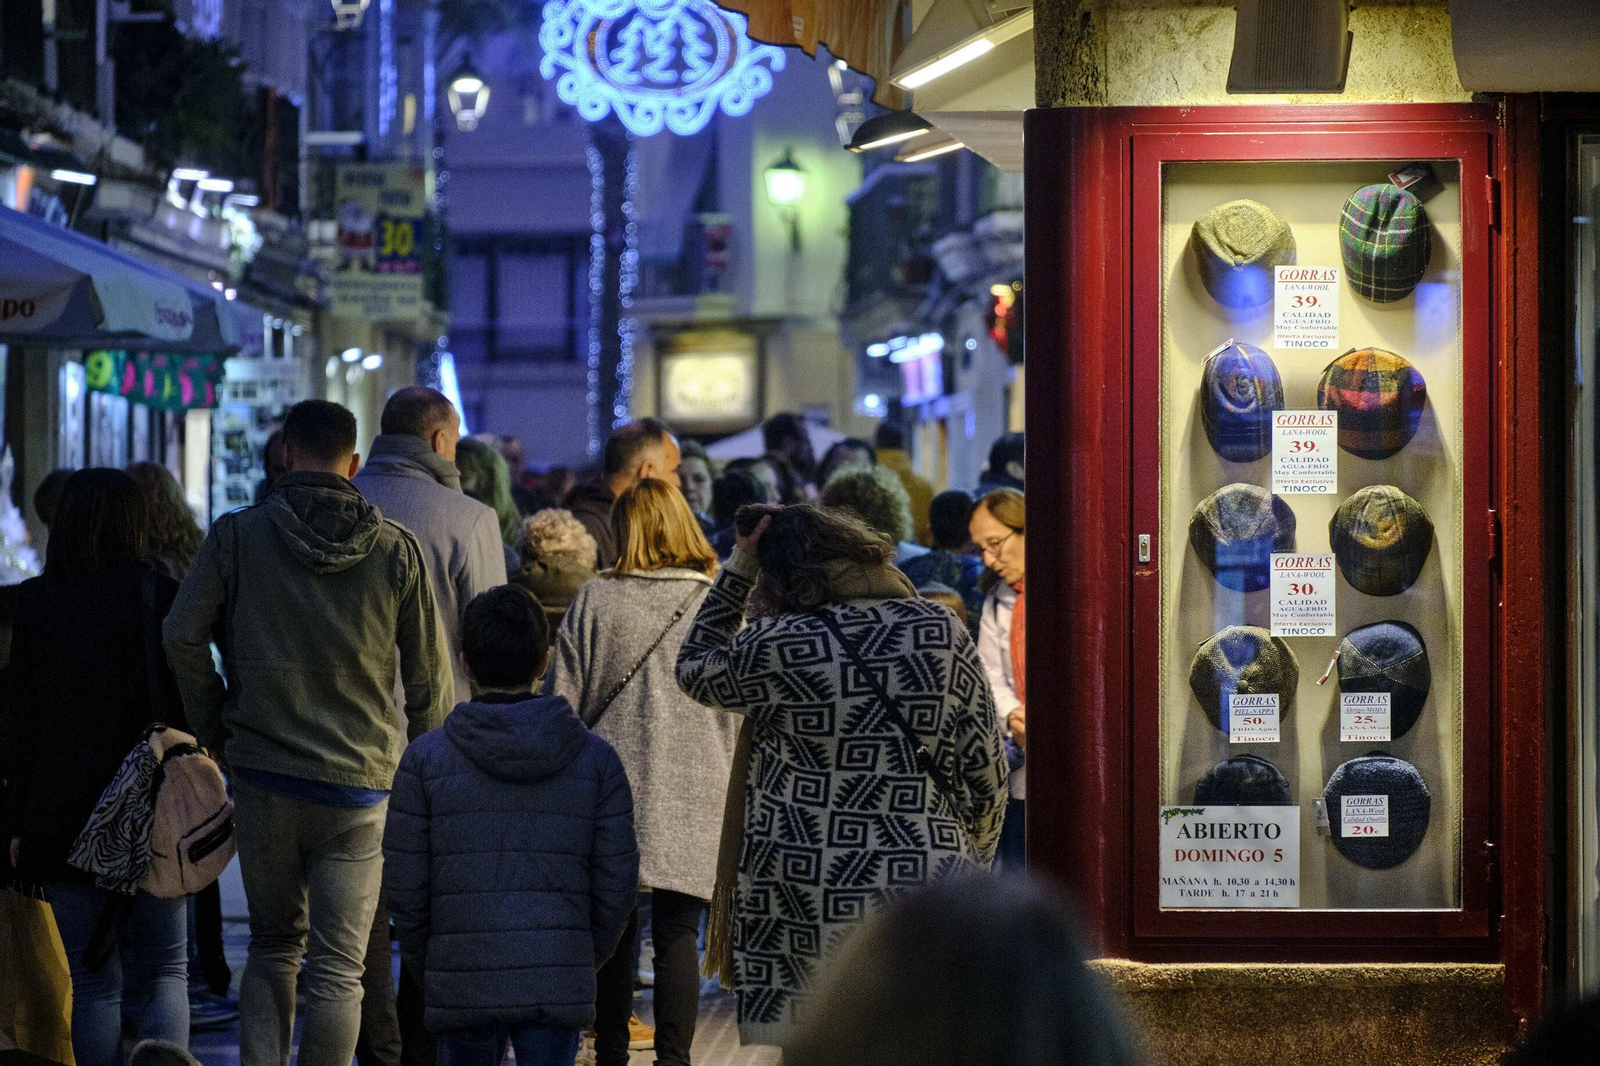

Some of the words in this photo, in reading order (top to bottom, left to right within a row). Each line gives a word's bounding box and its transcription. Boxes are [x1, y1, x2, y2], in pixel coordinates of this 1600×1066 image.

[379, 220, 414, 256] 30
[1279, 269, 1336, 280] GORRAS
[1277, 414, 1334, 425] GORRAS
[1275, 557, 1332, 568] GORRAS
[1233, 697, 1276, 706] GORRAS
[1344, 696, 1388, 704] GORRAS
[1177, 823, 1281, 839] ABIERTO
[1175, 849, 1264, 862] DOMINGO
[1274, 848, 1283, 862] 5
[1162, 876, 1208, 886] MAÑANA
[1214, 878, 1222, 886] h.
[1227, 878, 1250, 886] 10,30
[1265, 878, 1287, 886] 14,30
[1290, 878, 1295, 886] h
[1179, 889, 1214, 897] TARDE
